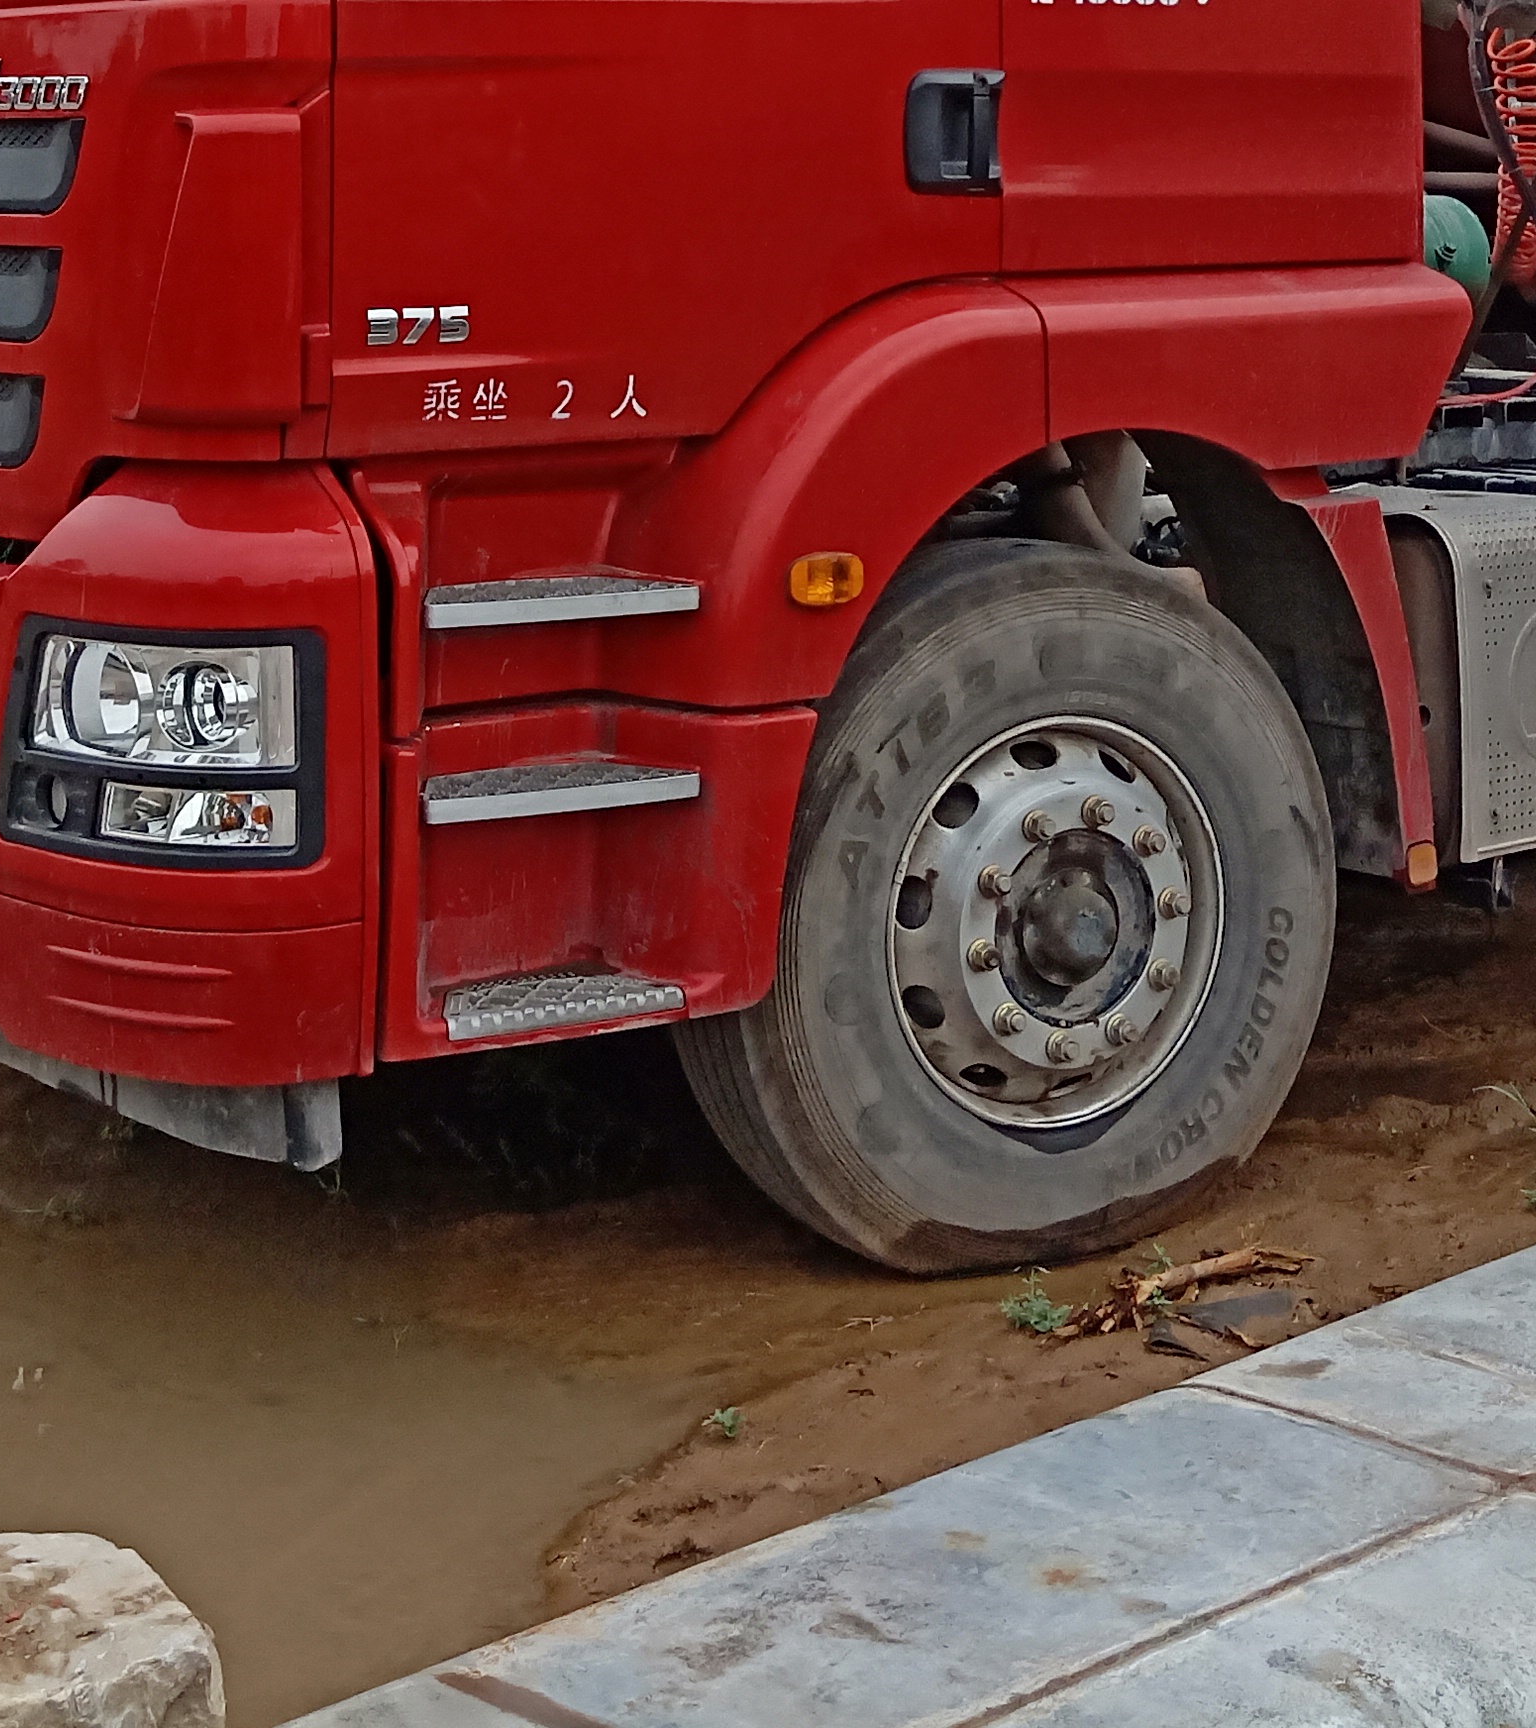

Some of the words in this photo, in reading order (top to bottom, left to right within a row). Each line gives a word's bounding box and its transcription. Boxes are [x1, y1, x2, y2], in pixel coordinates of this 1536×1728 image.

[366, 305, 470, 346] 375
[422, 378, 508, 421] 乘坐
[550, 379, 574, 420] 2
[610, 374, 647, 419] 人
[1223, 906, 1294, 1092] GOLDEN
